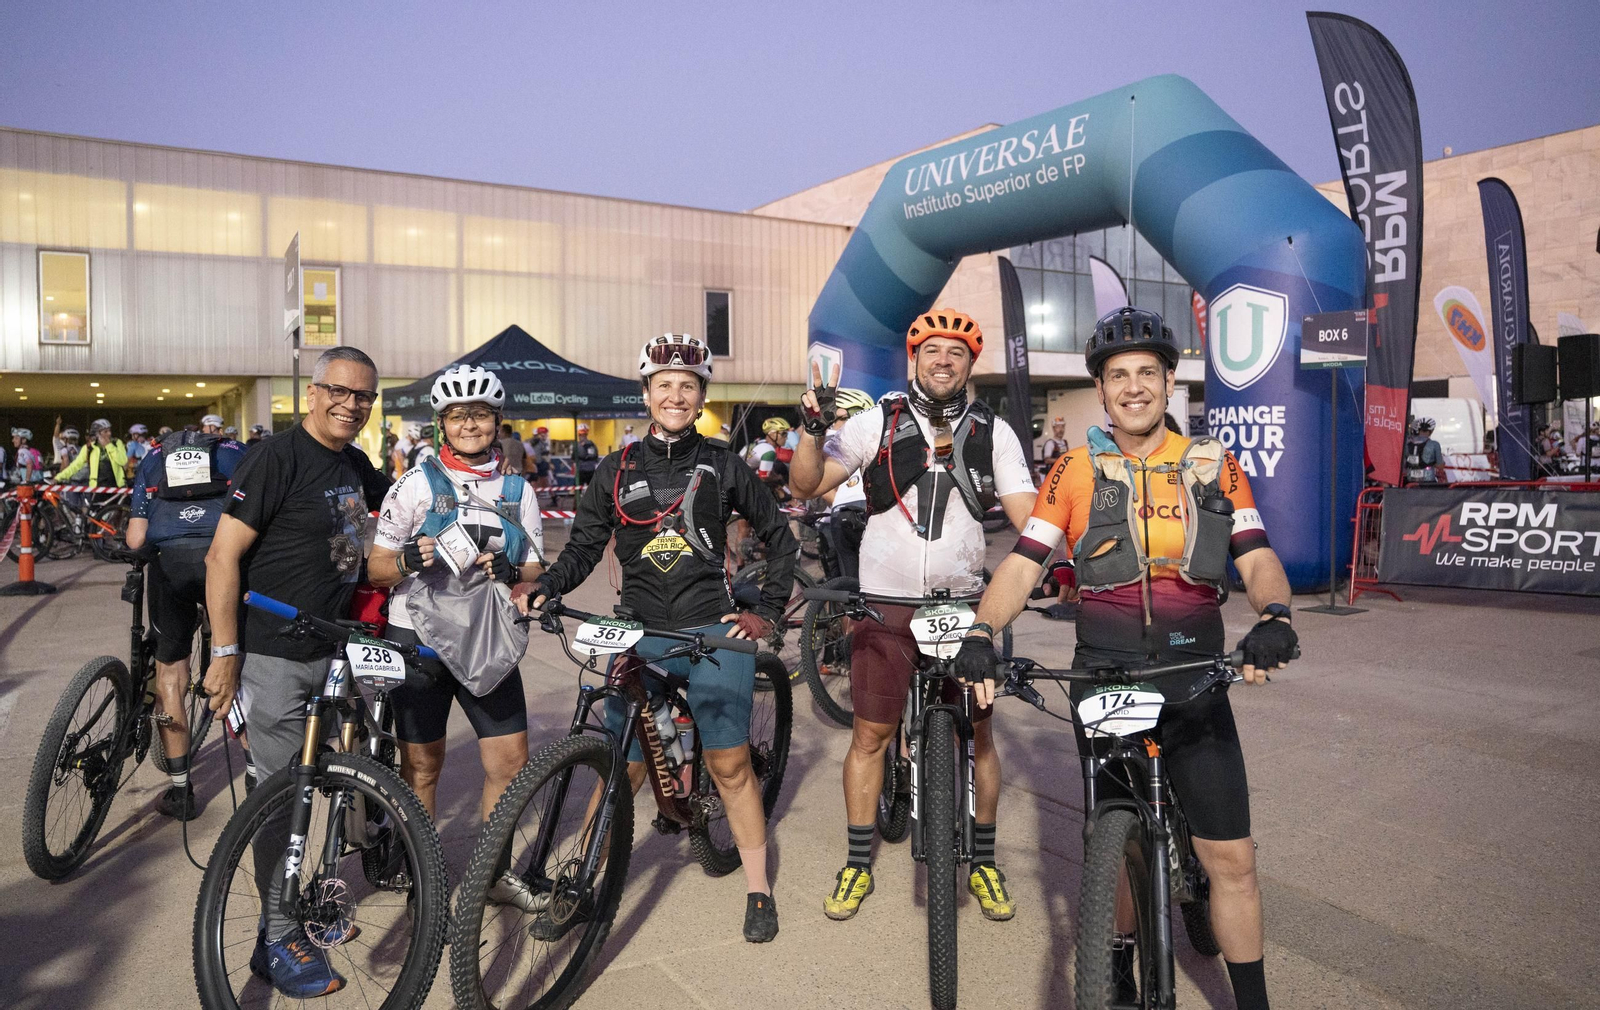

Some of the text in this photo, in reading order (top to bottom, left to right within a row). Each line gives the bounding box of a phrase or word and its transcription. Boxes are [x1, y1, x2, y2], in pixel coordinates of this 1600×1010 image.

[905, 113, 1090, 196] UNIVERSAE
[903, 153, 1086, 220] Instituto Superior de FP
[1318, 327, 1349, 343] BOX 6
[514, 393, 529, 403] We
[555, 393, 589, 406] Cycling
[612, 395, 647, 404] SKOD
[1208, 405, 1286, 426] CHANGE
[1208, 425, 1285, 449] YOUR
[174, 451, 202, 462] 304
[1233, 450, 1284, 478] AY
[1223, 450, 1239, 495] KODA
[1459, 502, 1558, 528] RPM
[646, 543, 669, 552] COSTA
[1436, 552, 1596, 574] We make people
[593, 626, 627, 642] 361
[926, 616, 960, 634] 362
[943, 632, 963, 640] DIEGO
[1169, 637, 1196, 646] DREAM
[361, 646, 393, 664] 238
[374, 664, 402, 673] GABRIELA
[1099, 692, 1136, 710] 174
[1105, 709, 1130, 717] DAVID
[640, 700, 675, 798] SPECIALIZED
[326, 764, 357, 777] ARDENT
[285, 833, 306, 880] FOX
